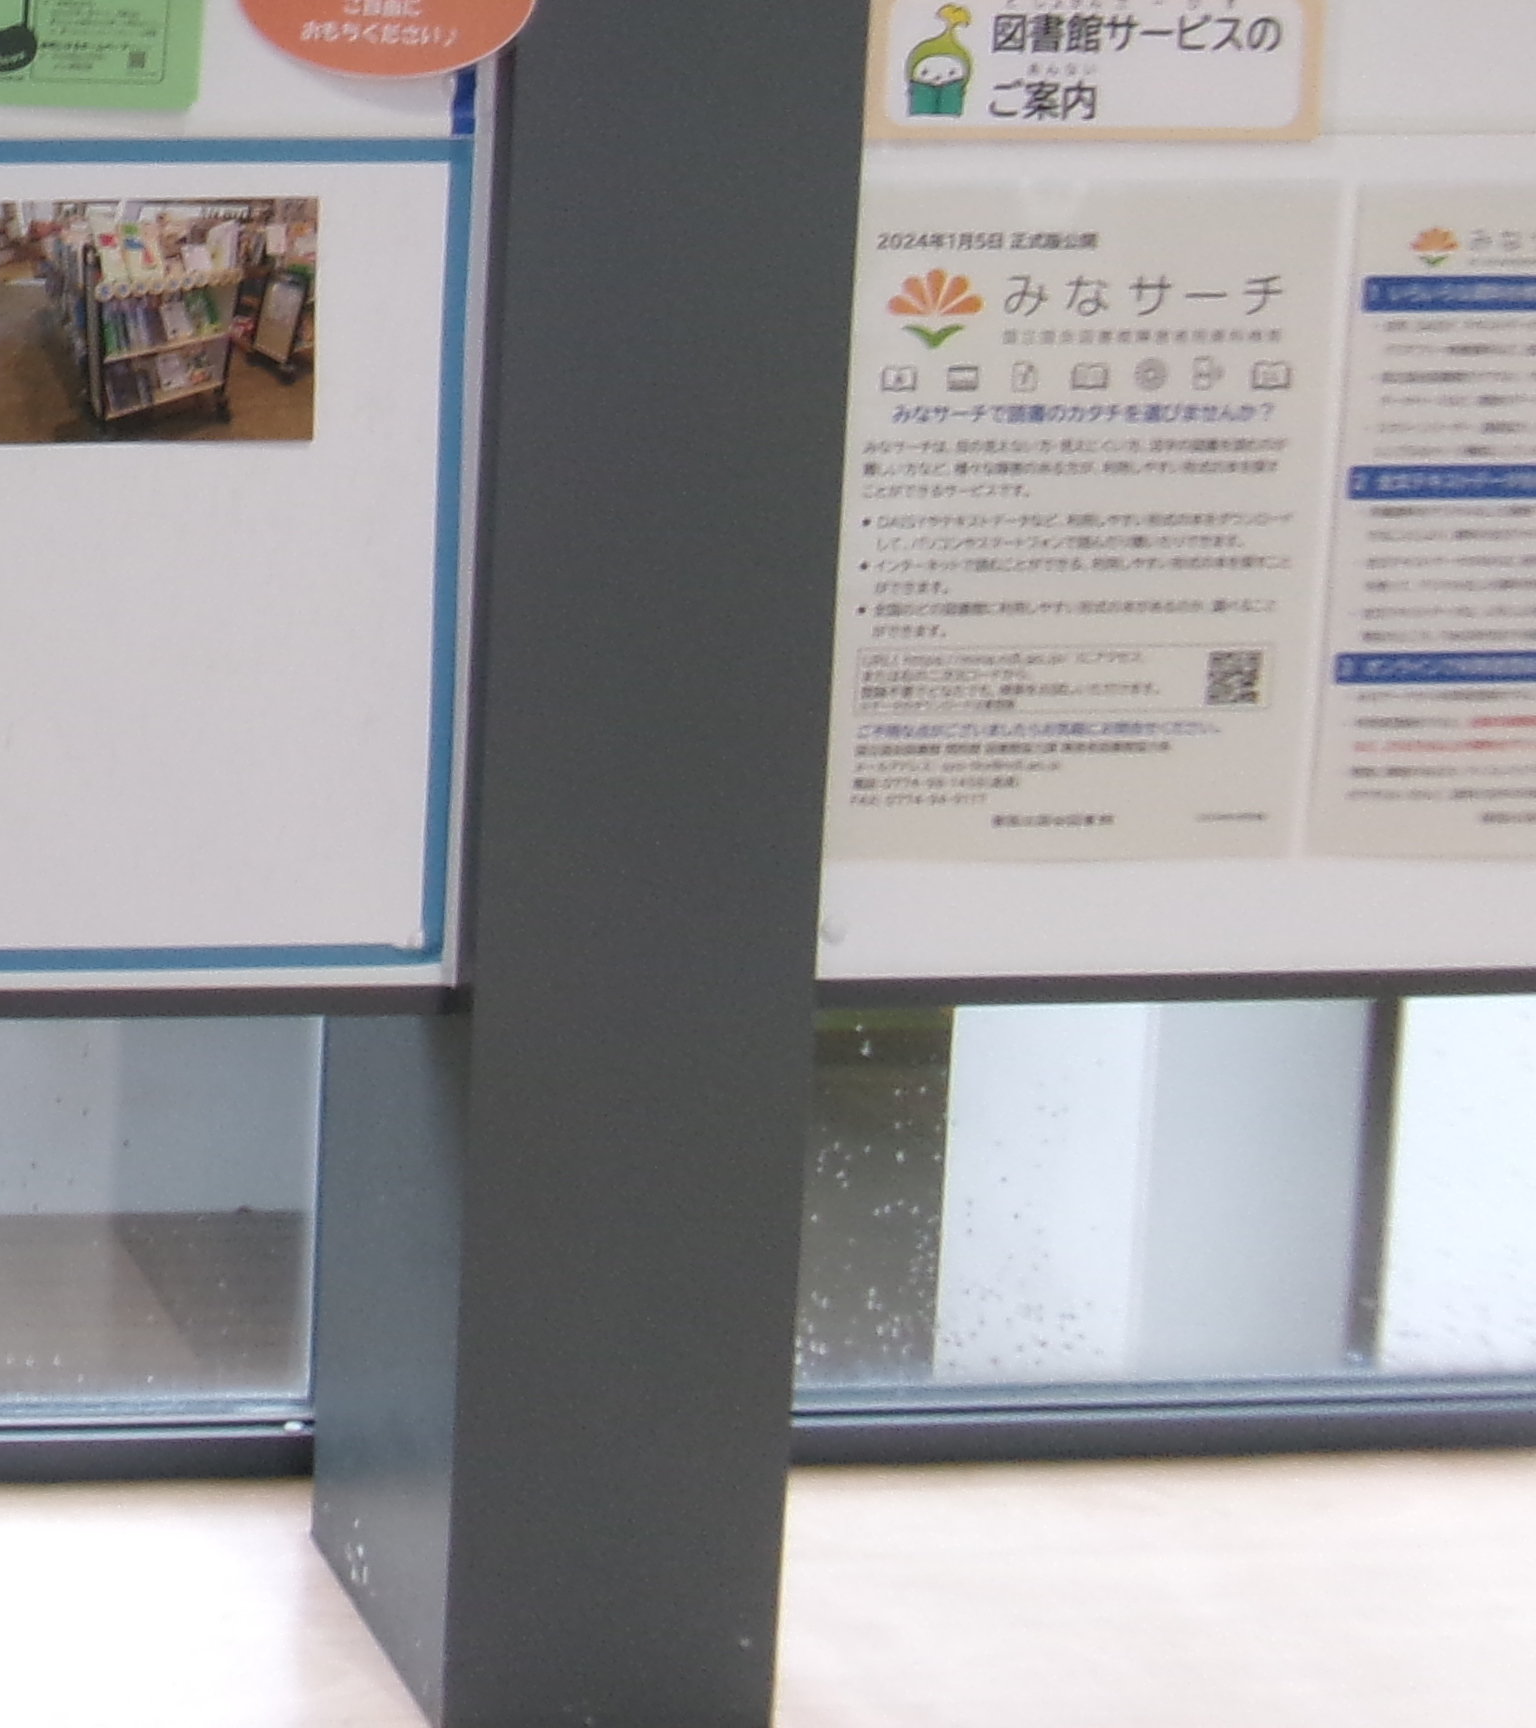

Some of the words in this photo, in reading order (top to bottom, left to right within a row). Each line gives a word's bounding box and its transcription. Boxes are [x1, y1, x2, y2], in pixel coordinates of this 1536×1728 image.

[992, 12, 1283, 55] 図書館サービスの
[989, 80, 1099, 121] ご案内
[1002, 274, 1284, 318] みなサーチ
